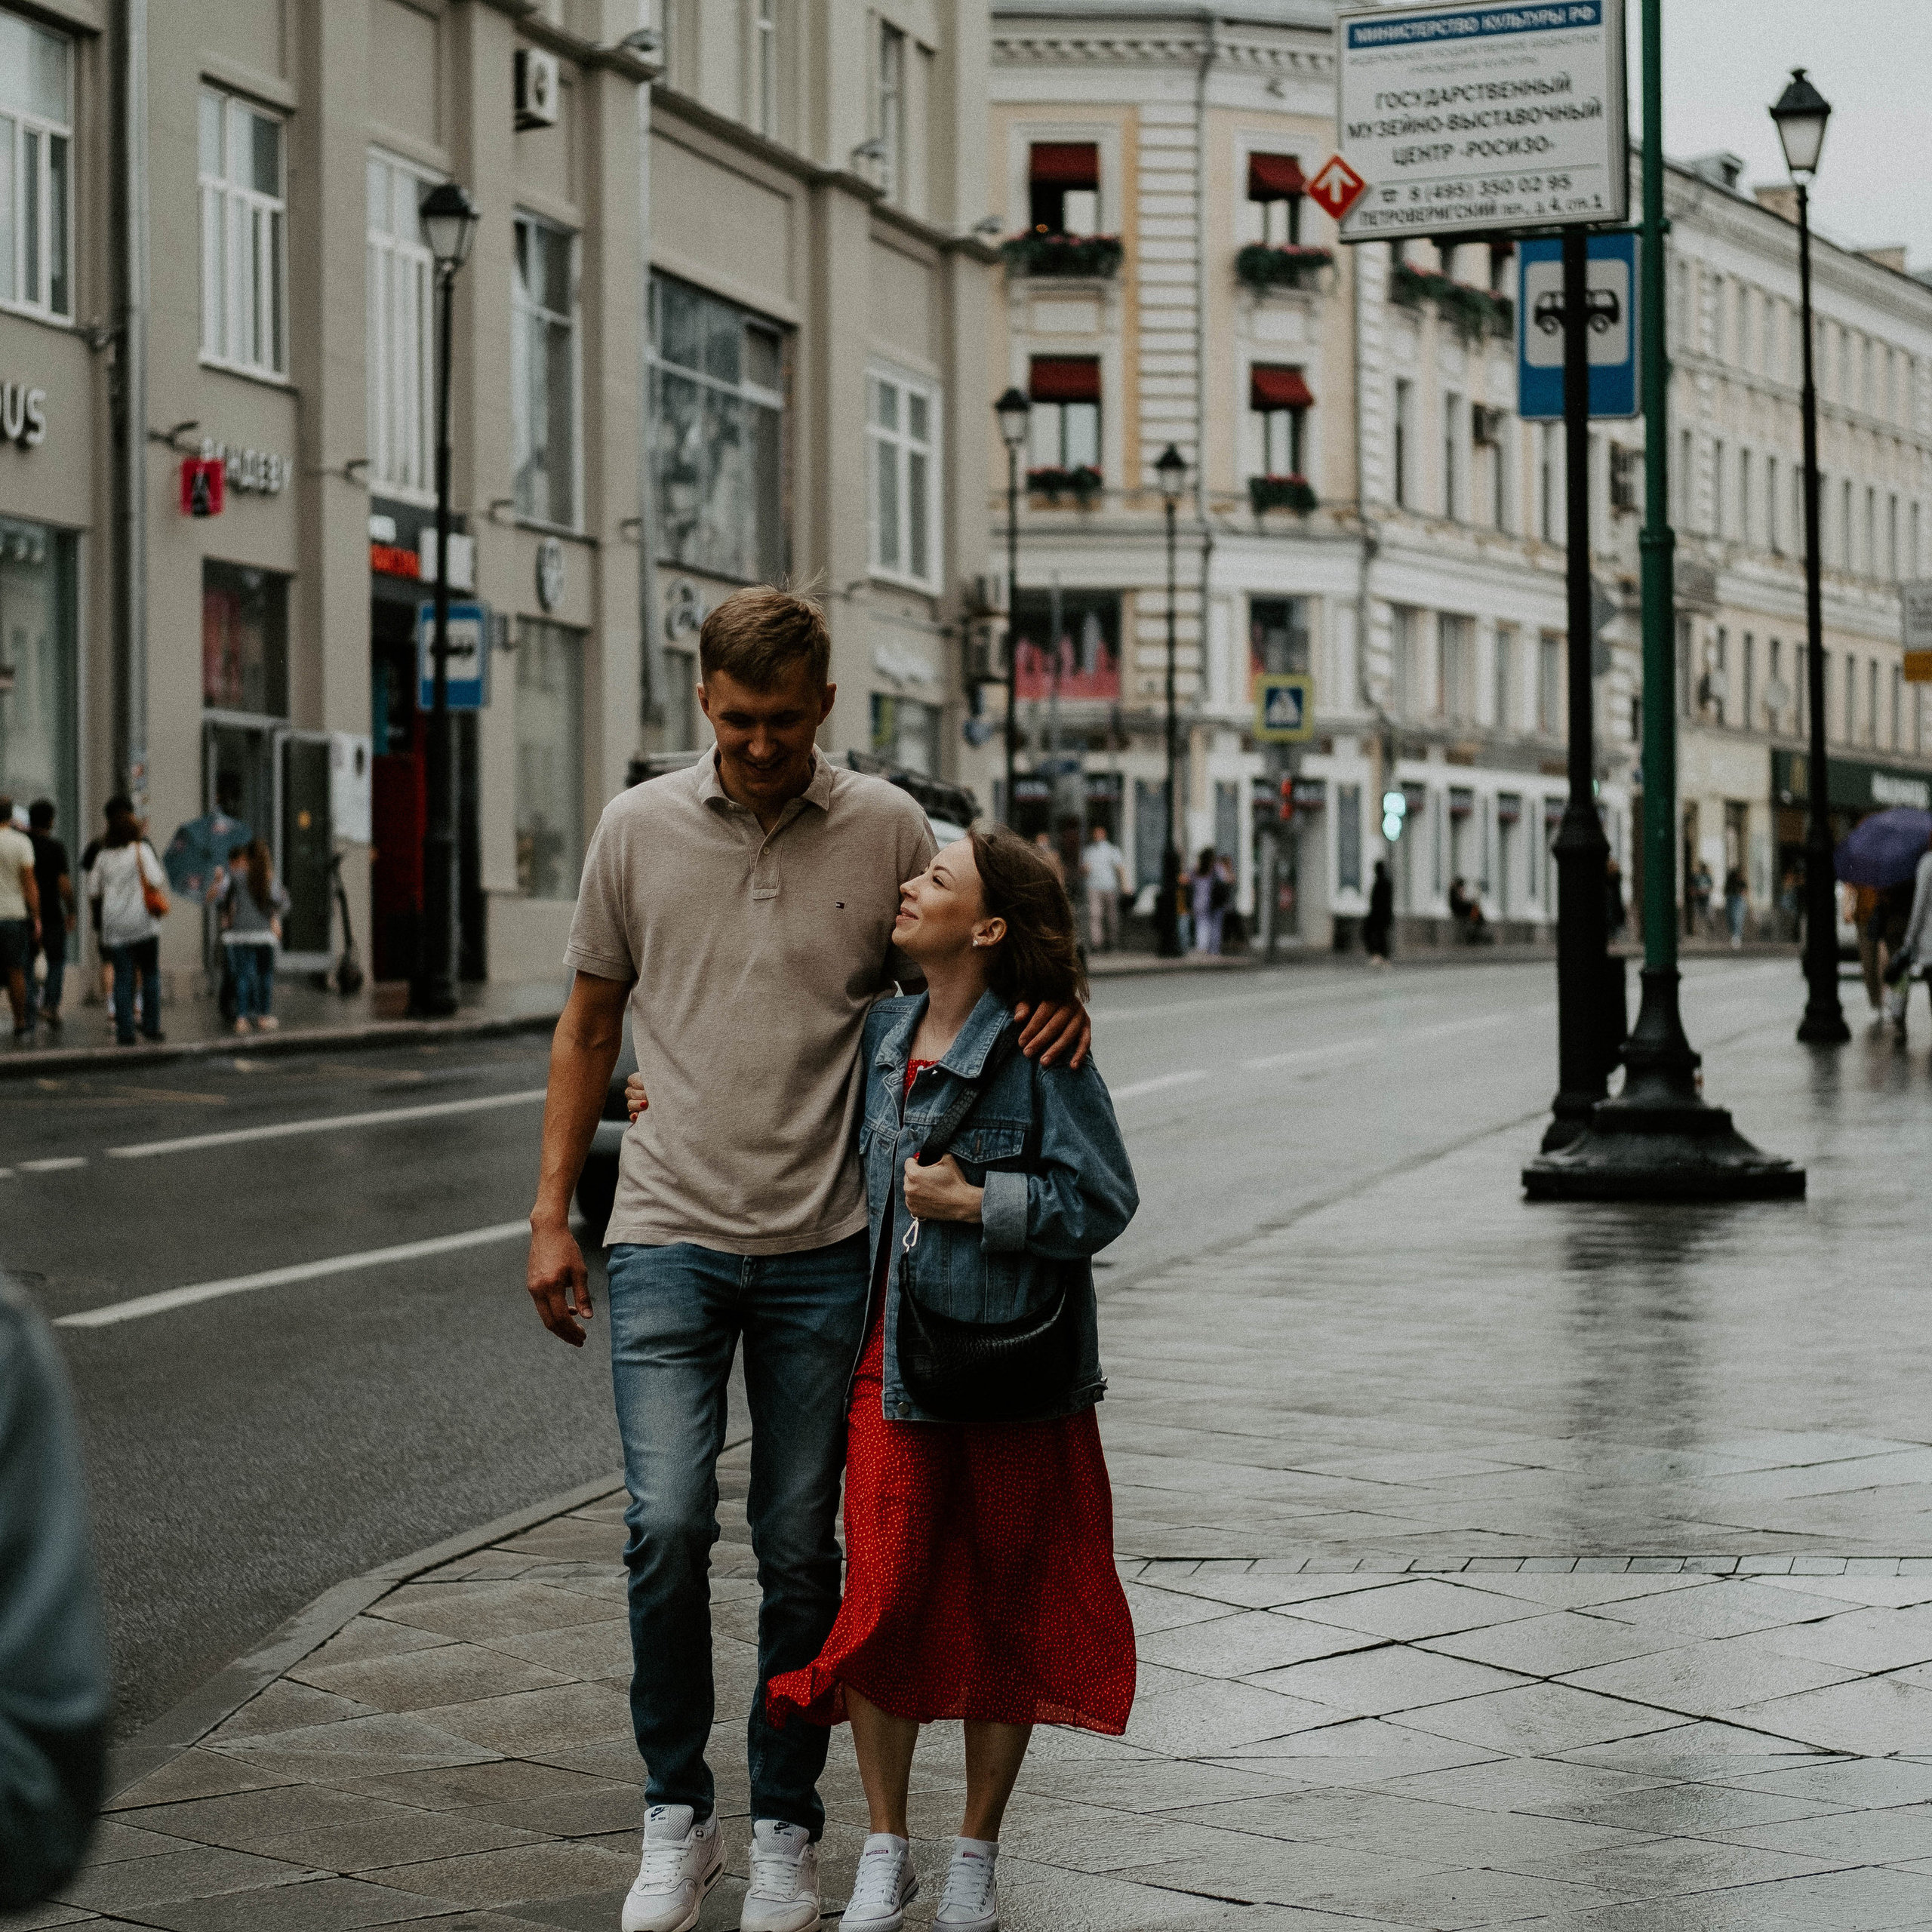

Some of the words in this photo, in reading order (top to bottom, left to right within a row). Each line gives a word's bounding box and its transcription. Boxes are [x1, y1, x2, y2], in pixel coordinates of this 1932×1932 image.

[1354, 17, 1480, 43] МИНИСТЕРСТВО
[1481, 8, 1566, 30] КУЛЬТУРЫ
[1568, 5, 1596, 23] РФ
[1375, 70, 1572, 109] ГОСУДАРСТВЕННЫЙ
[1347, 95, 1602, 140] МУЗЕЙНО-ВЫСТАВОЧНЫЙ
[1392, 143, 1455, 166] ЦЕНТР
[0, 381, 46, 445] US
